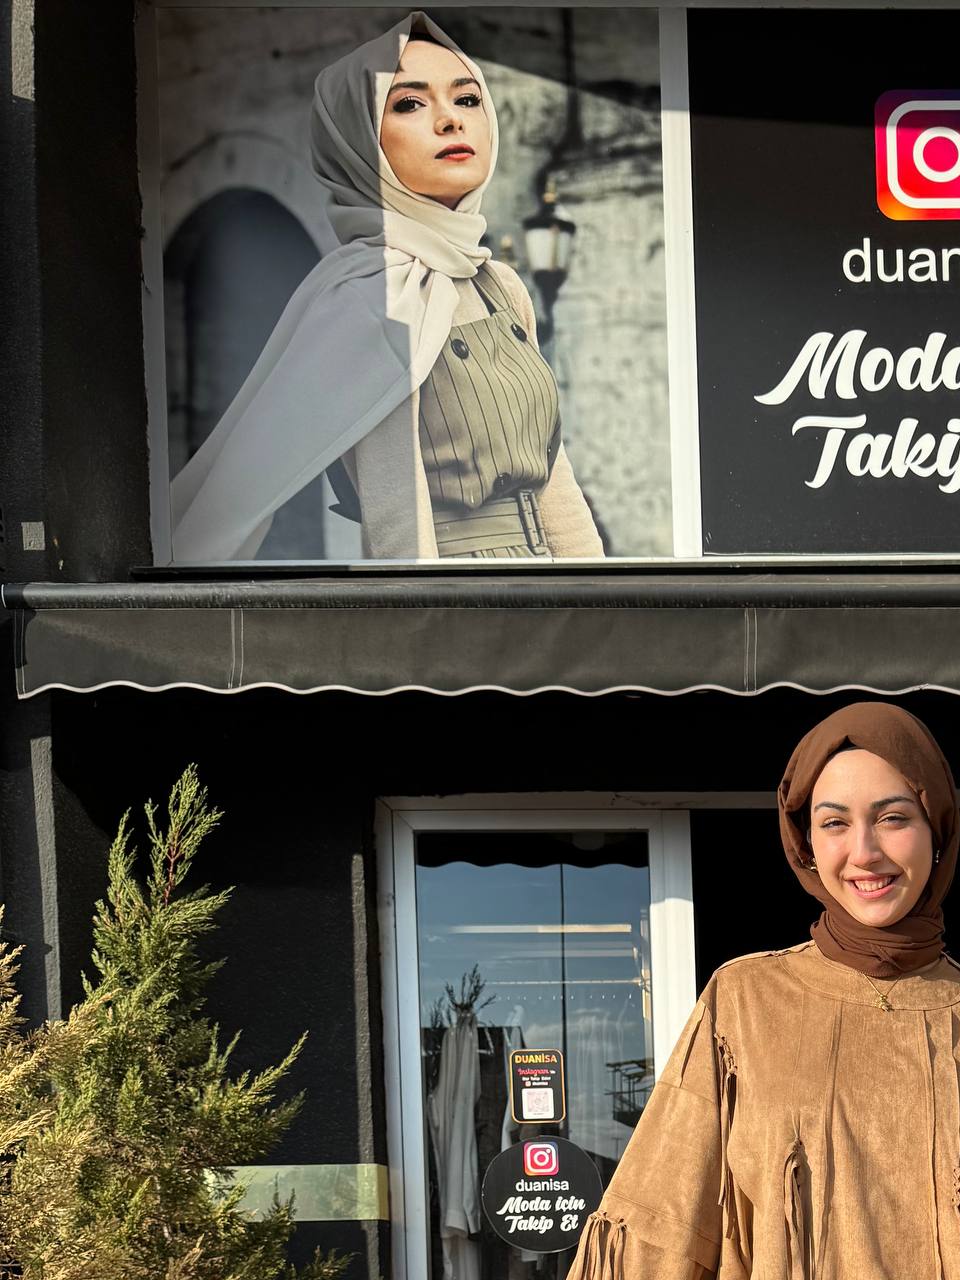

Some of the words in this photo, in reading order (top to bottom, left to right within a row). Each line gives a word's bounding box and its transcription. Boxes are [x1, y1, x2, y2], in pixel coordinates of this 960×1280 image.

[515, 1178, 570, 1192] duanisa
[496, 1196, 551, 1215] Moda
[555, 1195, 586, 1213] için
[505, 1215, 553, 1234] Takip
[560, 1214, 579, 1232] Et
